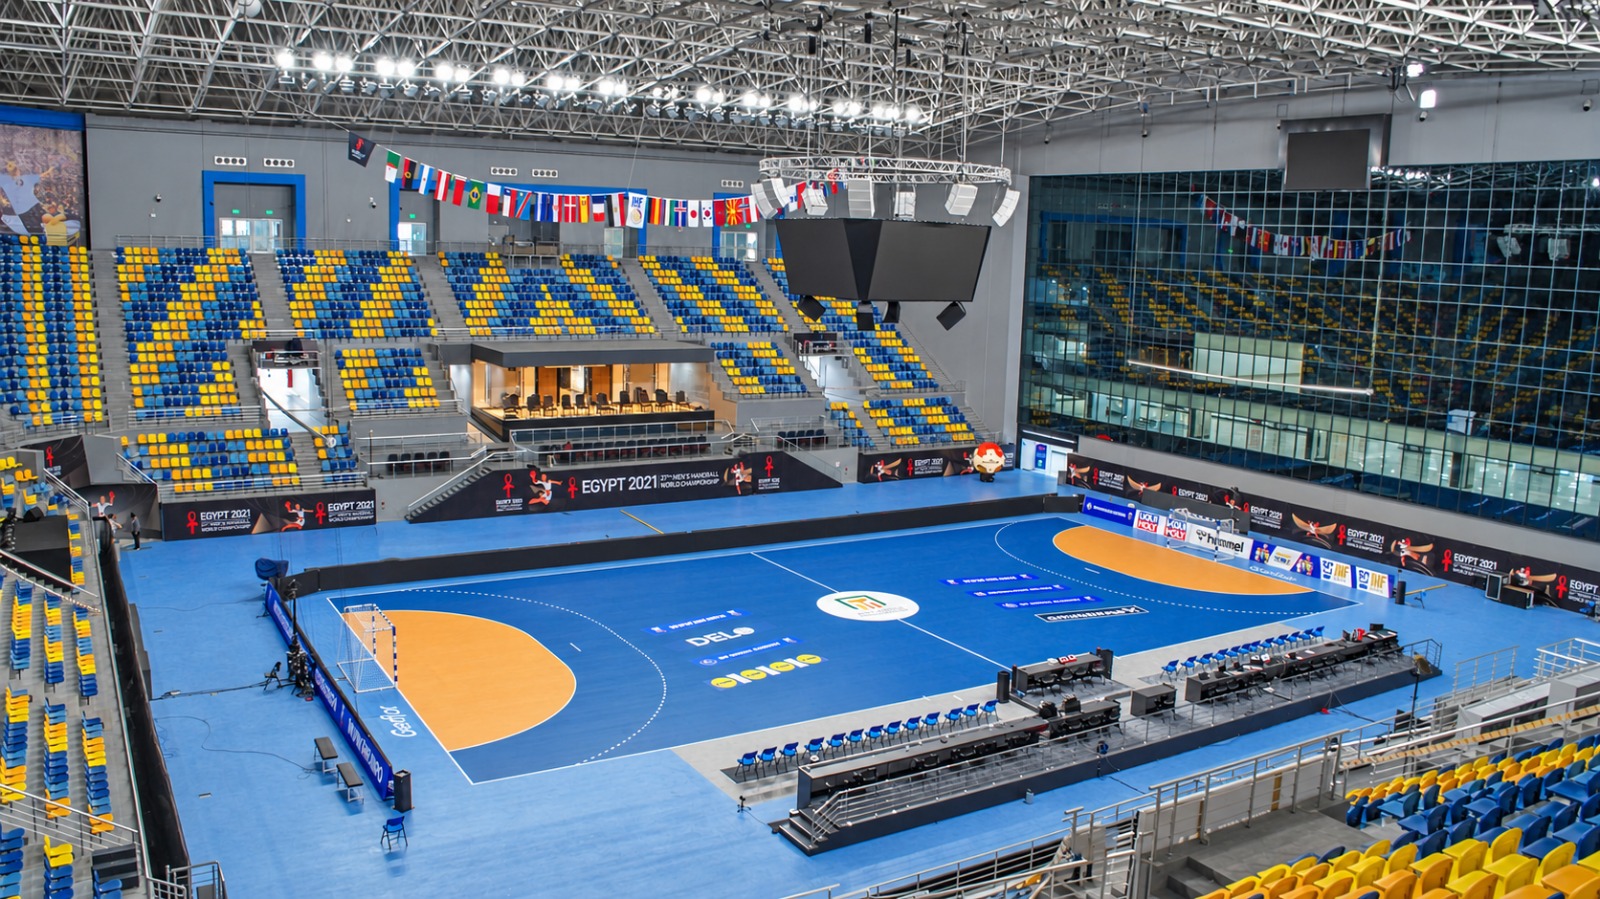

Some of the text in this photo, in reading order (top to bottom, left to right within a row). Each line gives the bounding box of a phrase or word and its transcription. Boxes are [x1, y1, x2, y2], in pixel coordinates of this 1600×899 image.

[582, 475, 657, 494] EGYPT 2021
[328, 500, 374, 512] EGYPT 2021
[200, 509, 251, 521] EGYPT 2021
[1347, 528, 1385, 545] EGYPT 2021
[1453, 553, 1498, 571] EGYPT 2021
[1569, 579, 1599, 594] EGYPT
